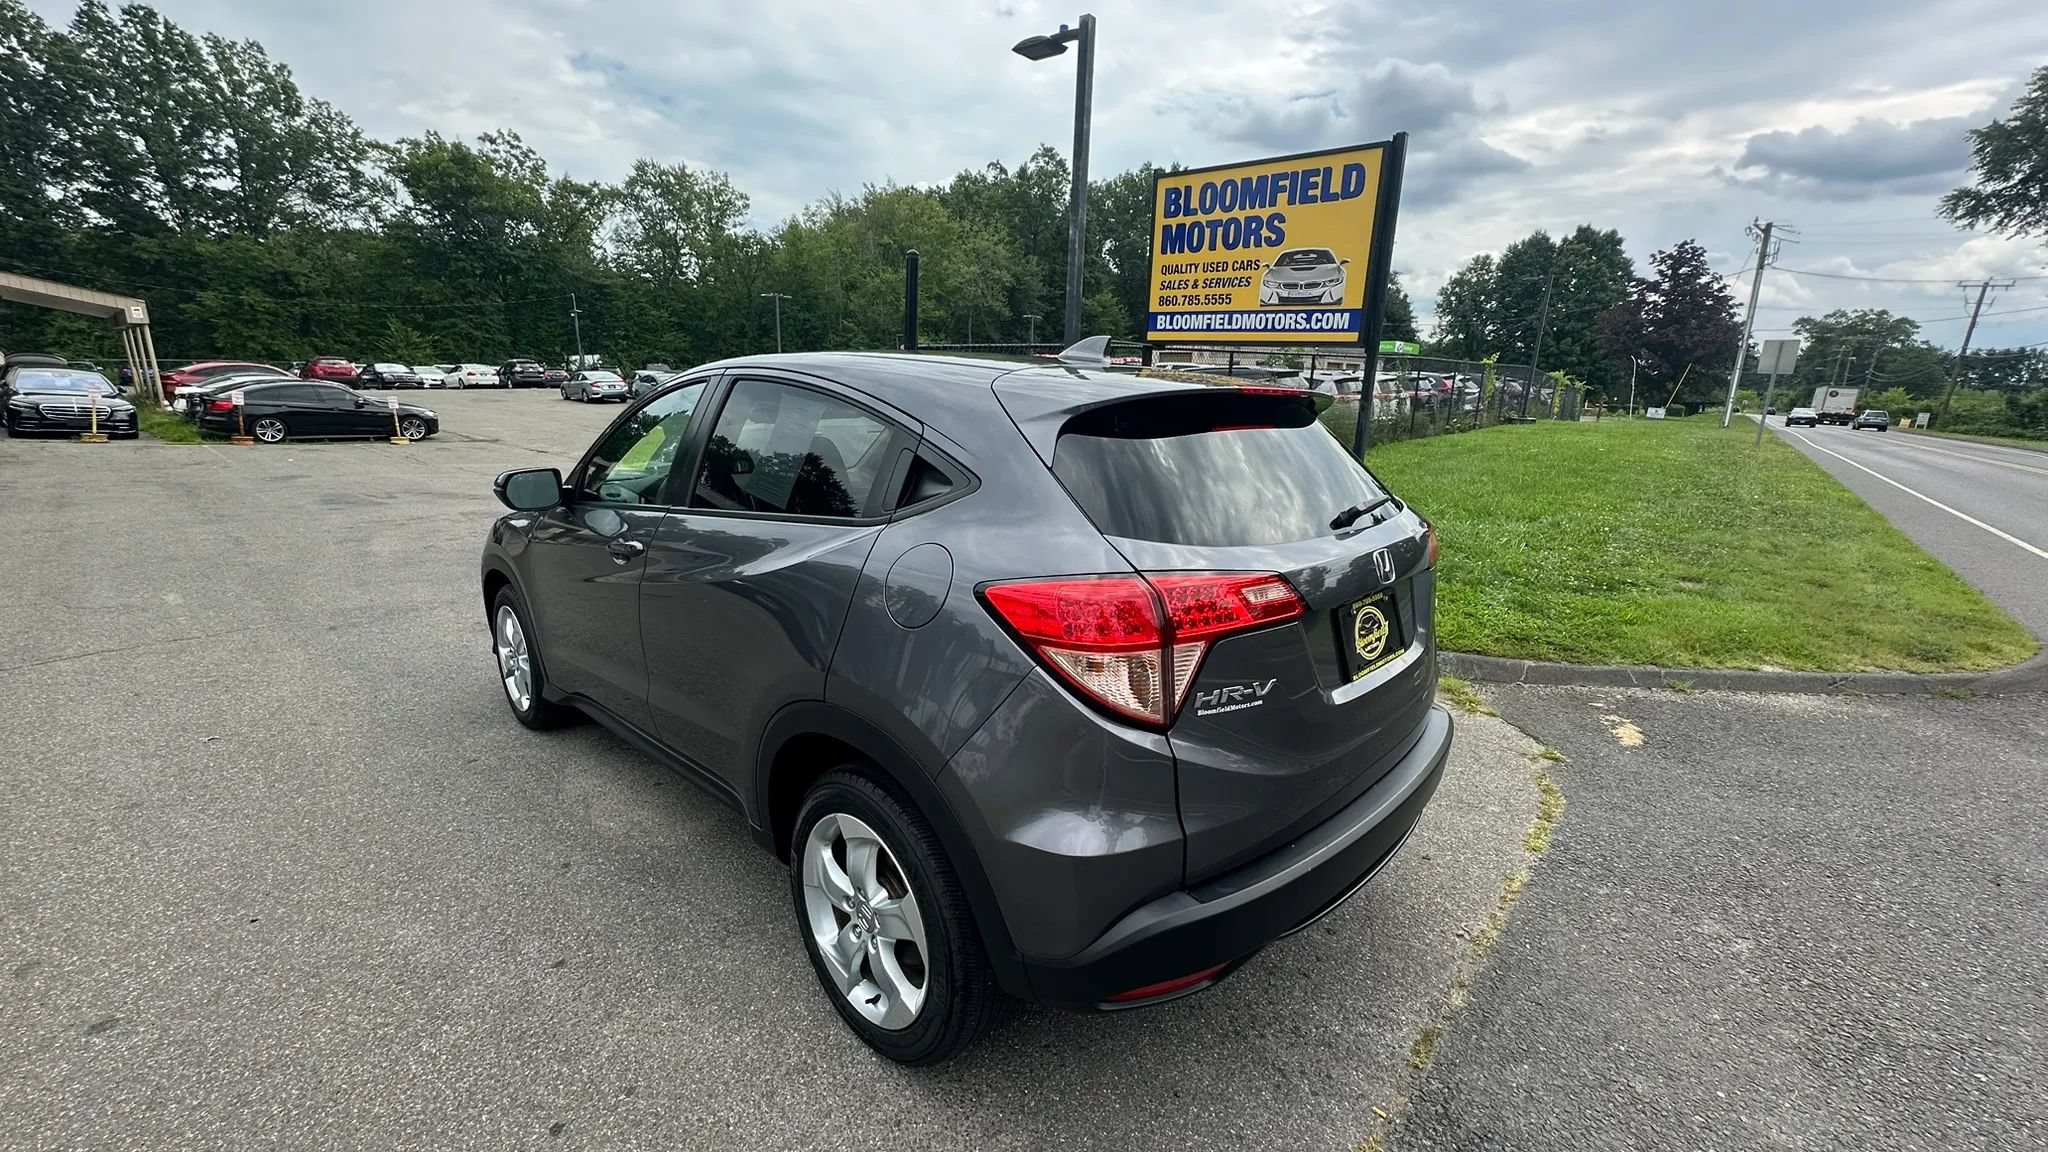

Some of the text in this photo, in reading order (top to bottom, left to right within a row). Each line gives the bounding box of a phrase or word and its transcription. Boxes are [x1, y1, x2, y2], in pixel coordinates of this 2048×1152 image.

[1163, 162, 1366, 219] BLOOMFIELD
[1160, 212, 1286, 255] MOTORS
[1161, 259, 1261, 276] QUALITY USED CARS
[1159, 276, 1252, 291] SALES & SERVICES
[1158, 293, 1232, 307] 860.785.5555
[1156, 312, 1350, 331] BLOOMFIELDMOTORS.COM
[1194, 678, 1277, 708] HR-V
[1197, 700, 1263, 716] BloomfieldMotors.com
